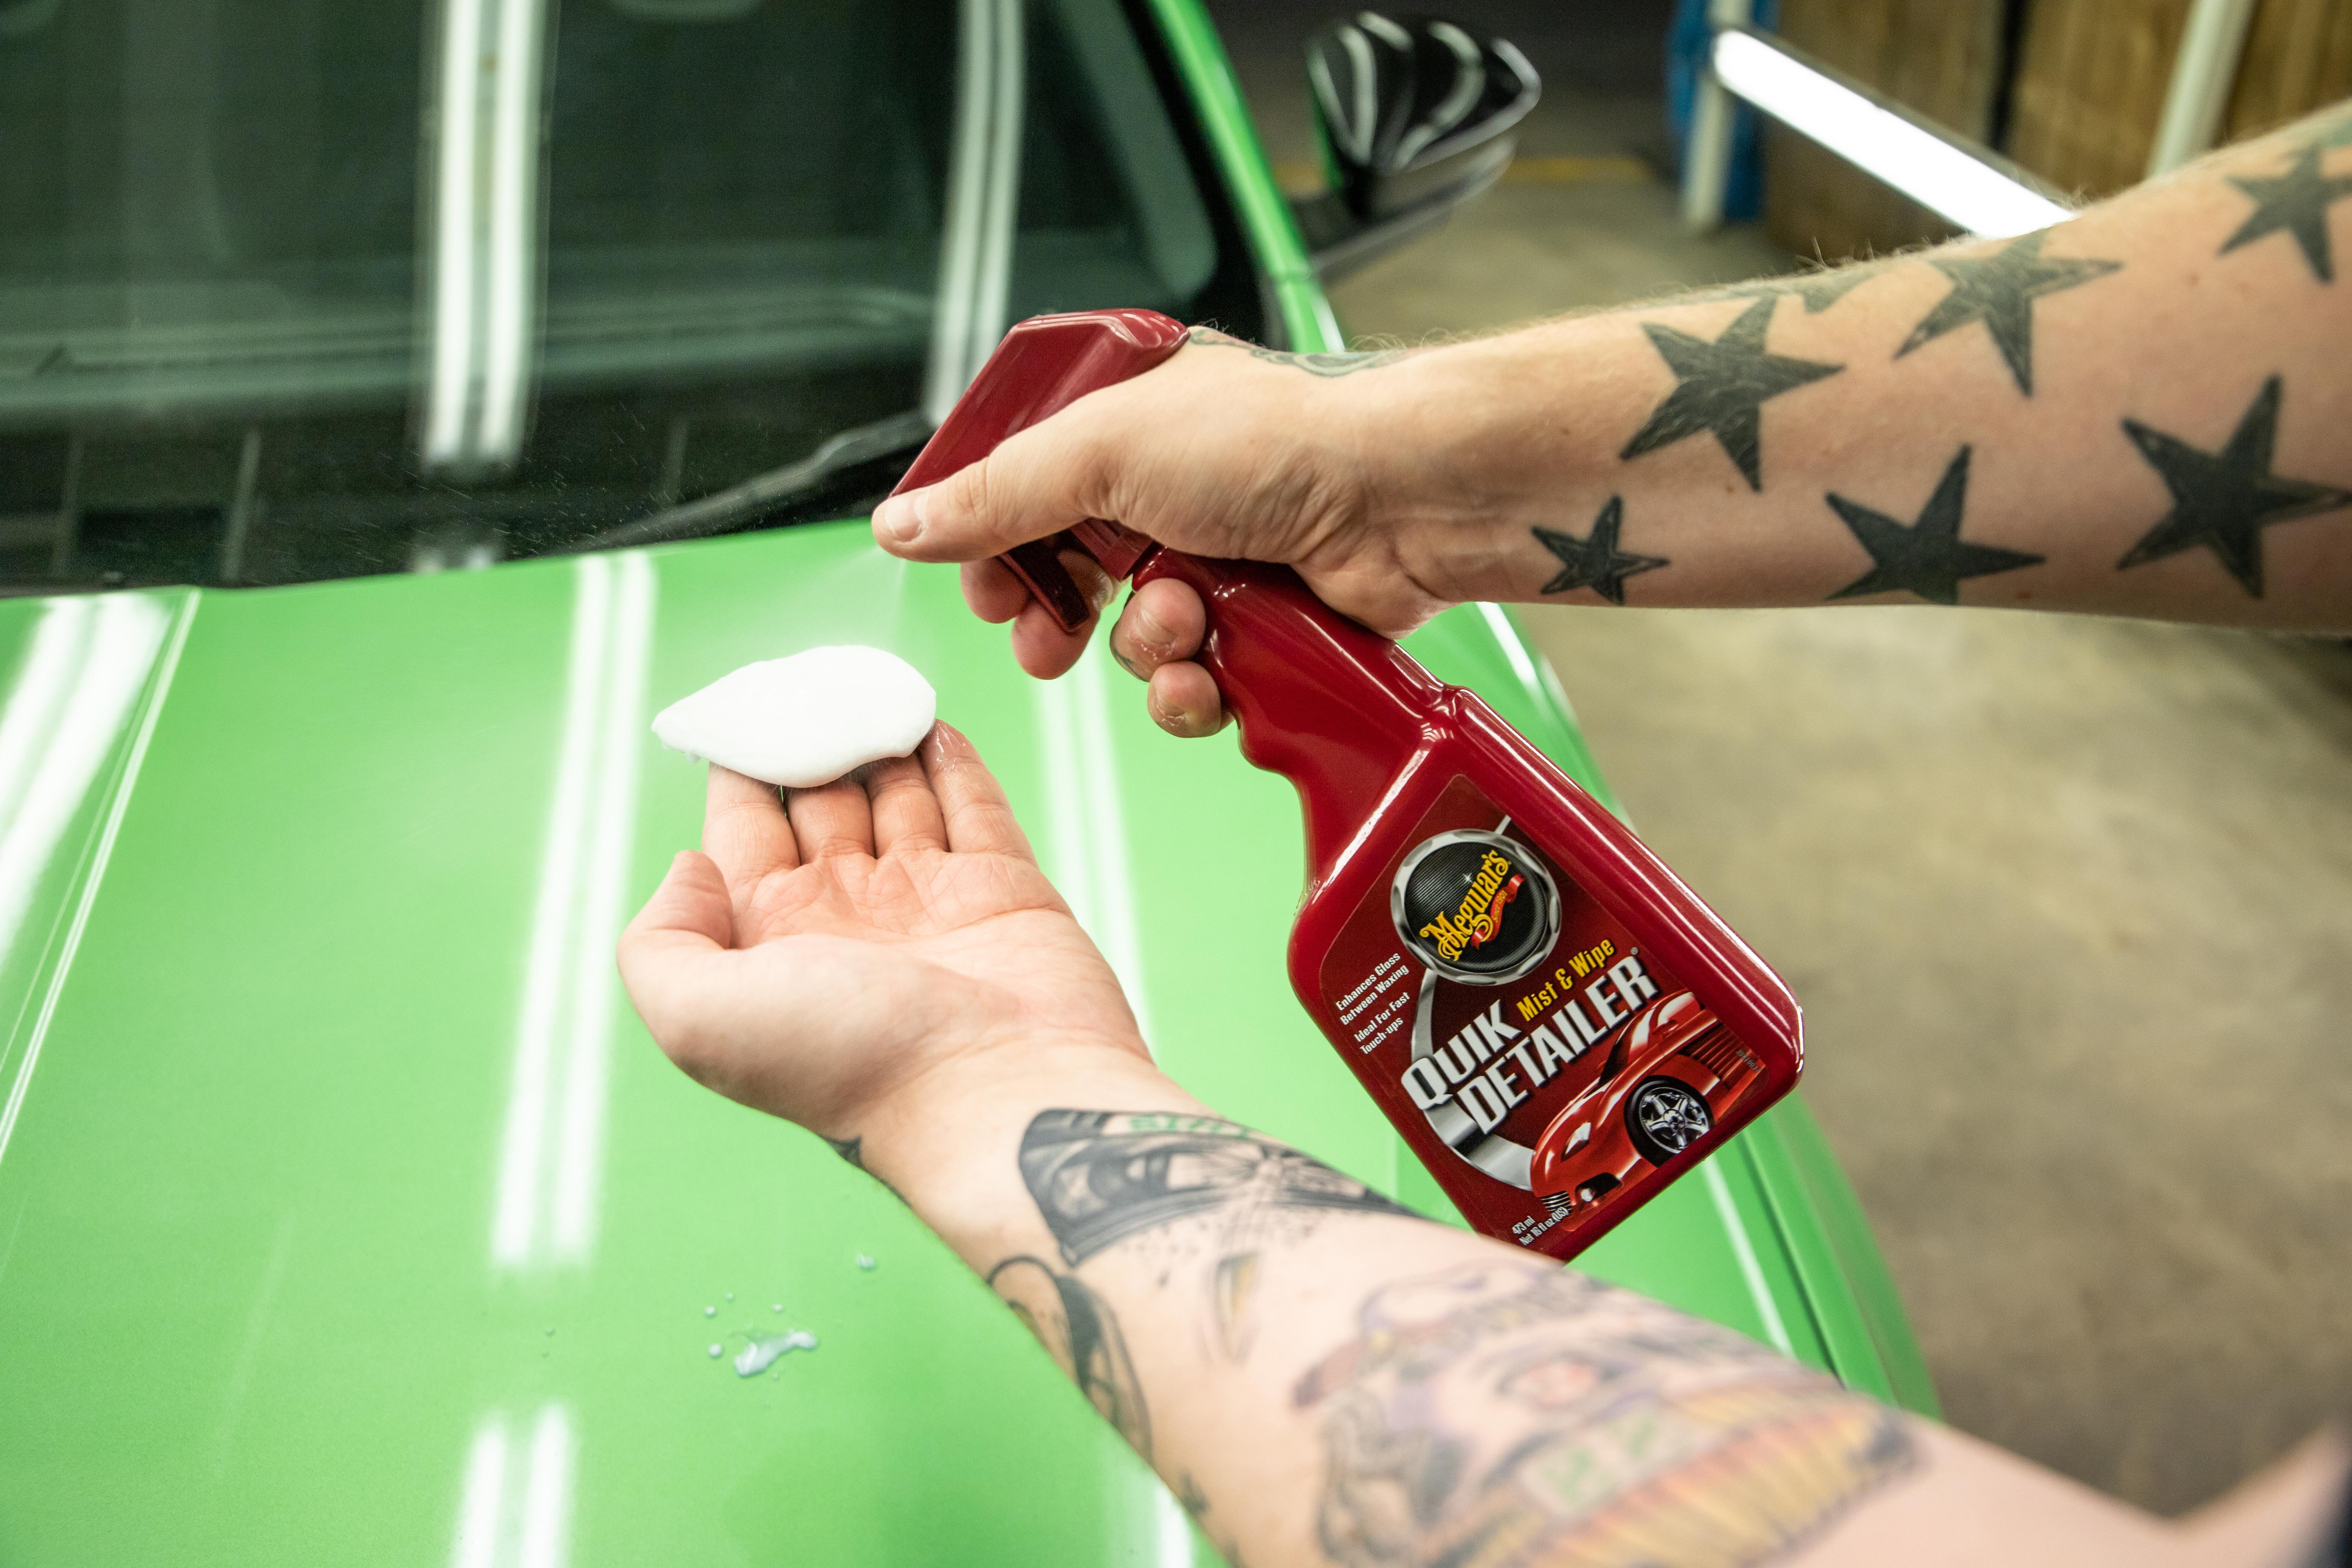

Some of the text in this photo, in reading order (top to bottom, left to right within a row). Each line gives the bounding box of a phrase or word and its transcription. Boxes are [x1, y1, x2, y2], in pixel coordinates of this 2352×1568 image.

[1419, 850, 1508, 961] Meguiar's
[1335, 953, 1401, 1011] Enhances Gloss
[1340, 965, 1409, 1025] Between Waxing
[1516, 939, 1614, 1021] Mist & Wipe
[1354, 992, 1410, 1042] Ideal For Fast
[1360, 1018, 1403, 1054] Touch-ups
[1457, 956, 1658, 1135] DETAILER
[1401, 999, 1521, 1110] QUIK
[1512, 1215, 1536, 1234] 473 ml
[1519, 1233, 1534, 1245] Net
[1530, 1227, 1542, 1237] 16
